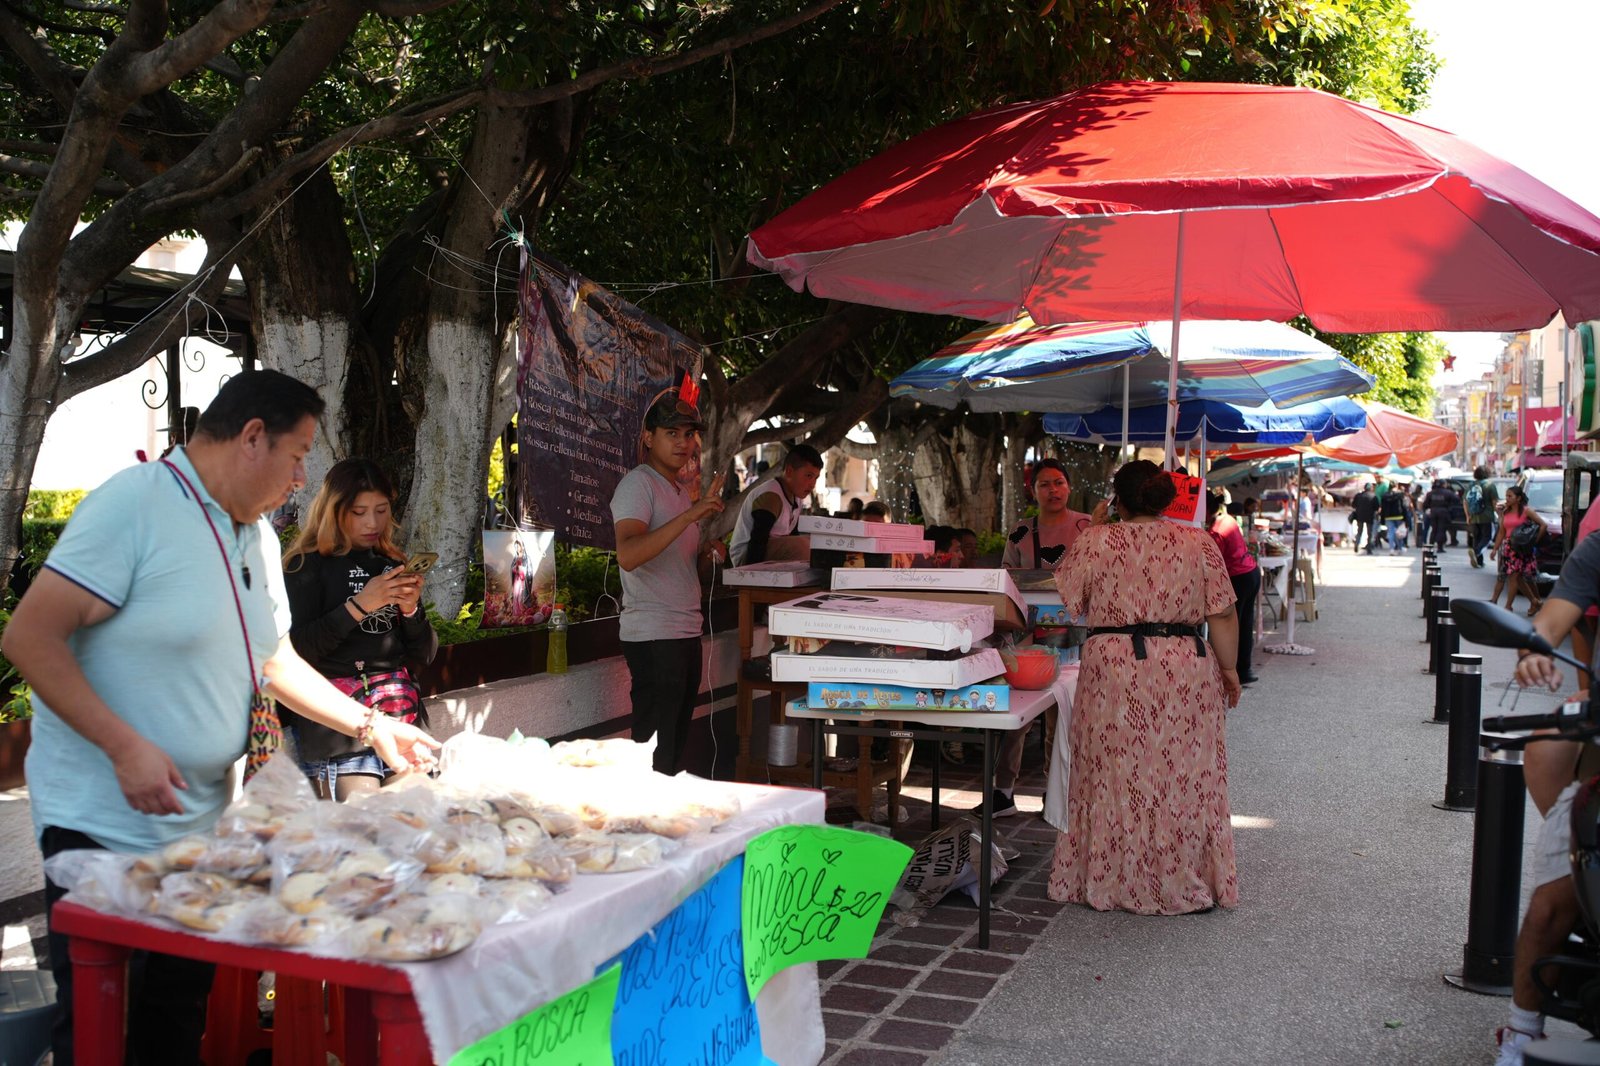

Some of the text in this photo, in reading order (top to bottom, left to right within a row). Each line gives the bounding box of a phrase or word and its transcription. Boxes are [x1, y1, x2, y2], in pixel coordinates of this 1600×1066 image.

[528, 378, 552, 397] Rosca
[528, 396, 552, 414] Rosca
[527, 415, 550, 432] Rosca
[526, 434, 549, 450] Rosca
[573, 490, 599, 507] Grande
[573, 507, 602, 525] Mediana
[571, 525, 592, 539] Chica
[828, 885, 883, 919] $20
[514, 991, 590, 1066] ROSCA
